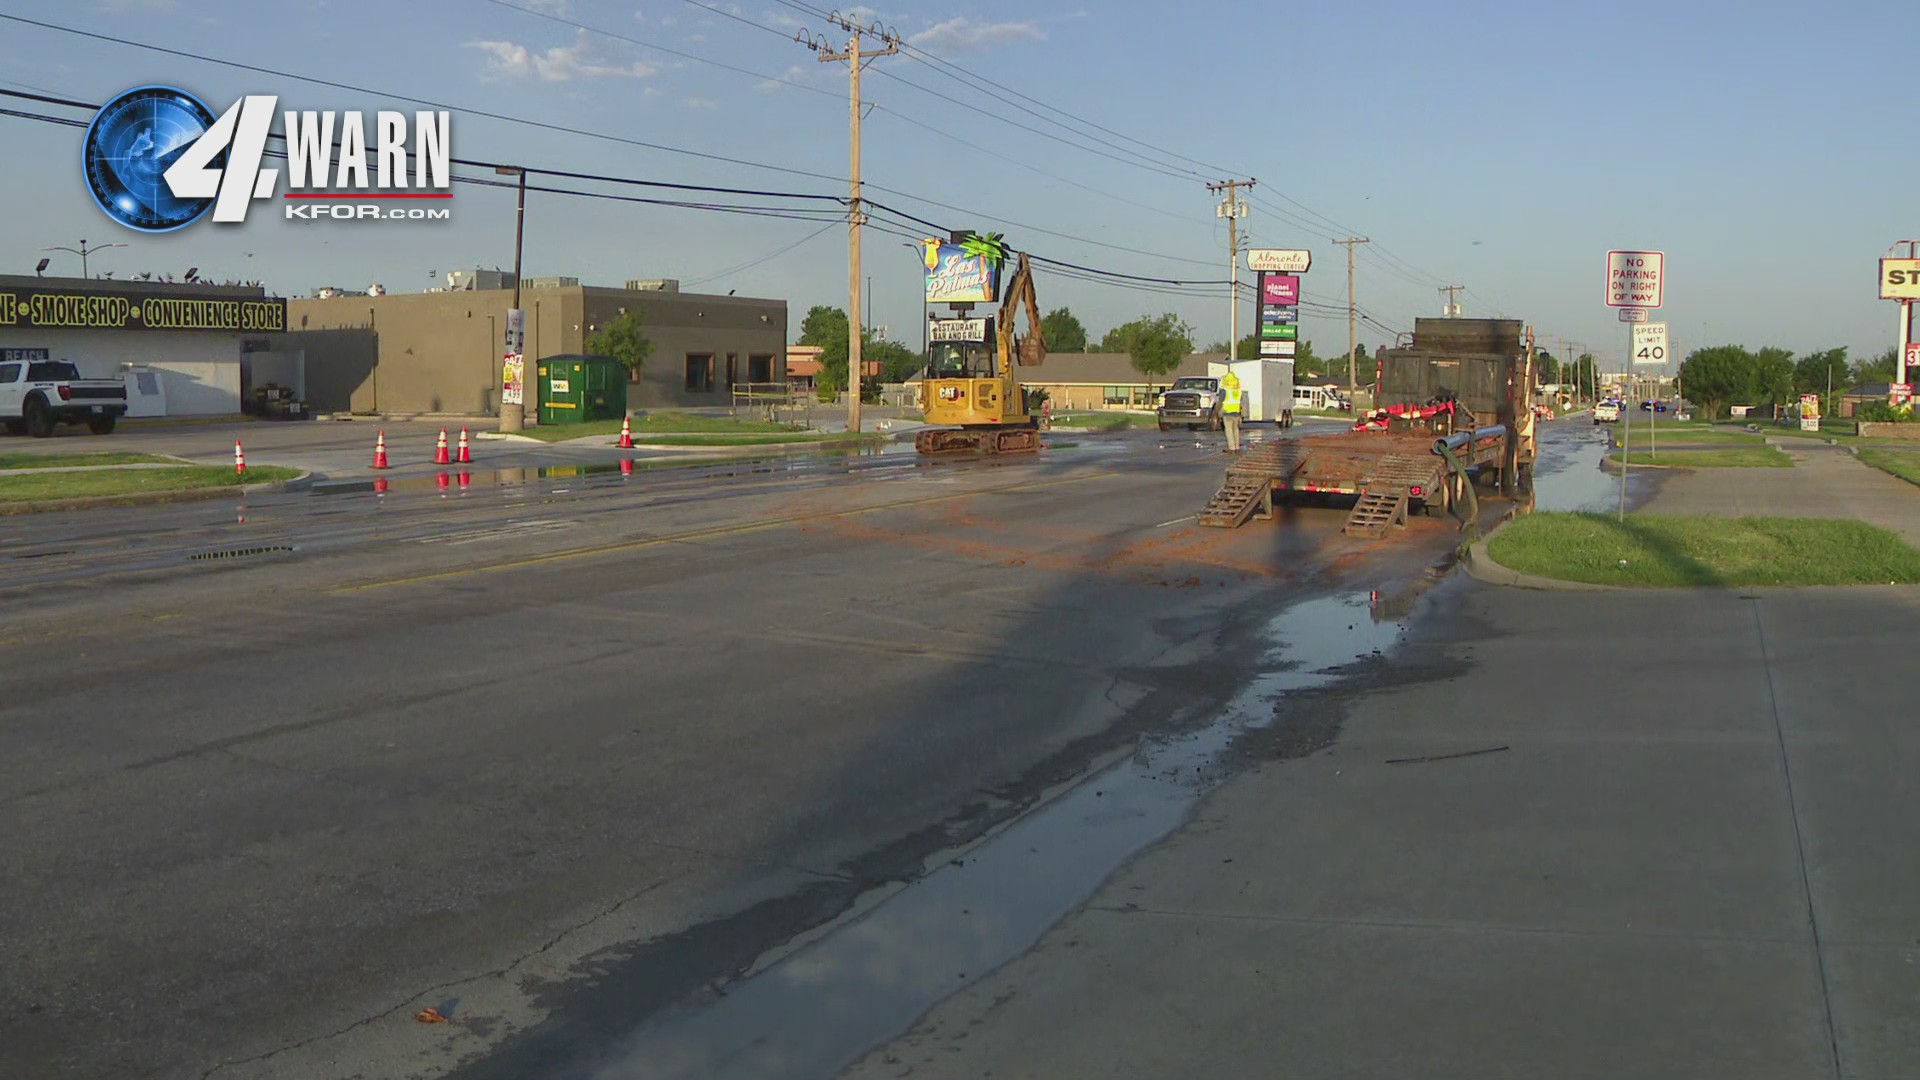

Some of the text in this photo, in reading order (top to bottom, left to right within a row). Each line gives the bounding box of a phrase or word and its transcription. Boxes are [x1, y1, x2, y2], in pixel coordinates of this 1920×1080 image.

[938, 255, 976, 278] Las
[1626, 259, 1644, 267] NO
[1613, 270, 1656, 279] PARKING
[926, 271, 992, 298] Palmas
[1267, 283, 1289, 292] planet
[1631, 282, 1656, 291] RIGHT
[1614, 293, 1653, 302] OF WAY
[31, 294, 86, 325] SMOKE
[87, 296, 129, 326] SHOP
[143, 298, 239, 329] CONVENIENCE
[242, 302, 283, 330] STORE
[933, 331, 982, 340] BAR AND GRILL
[1635, 327, 1664, 335] SPEED
[1638, 336, 1660, 344] LIMIT
[1637, 346, 1664, 359] 40
[939, 387, 955, 398] CAT
